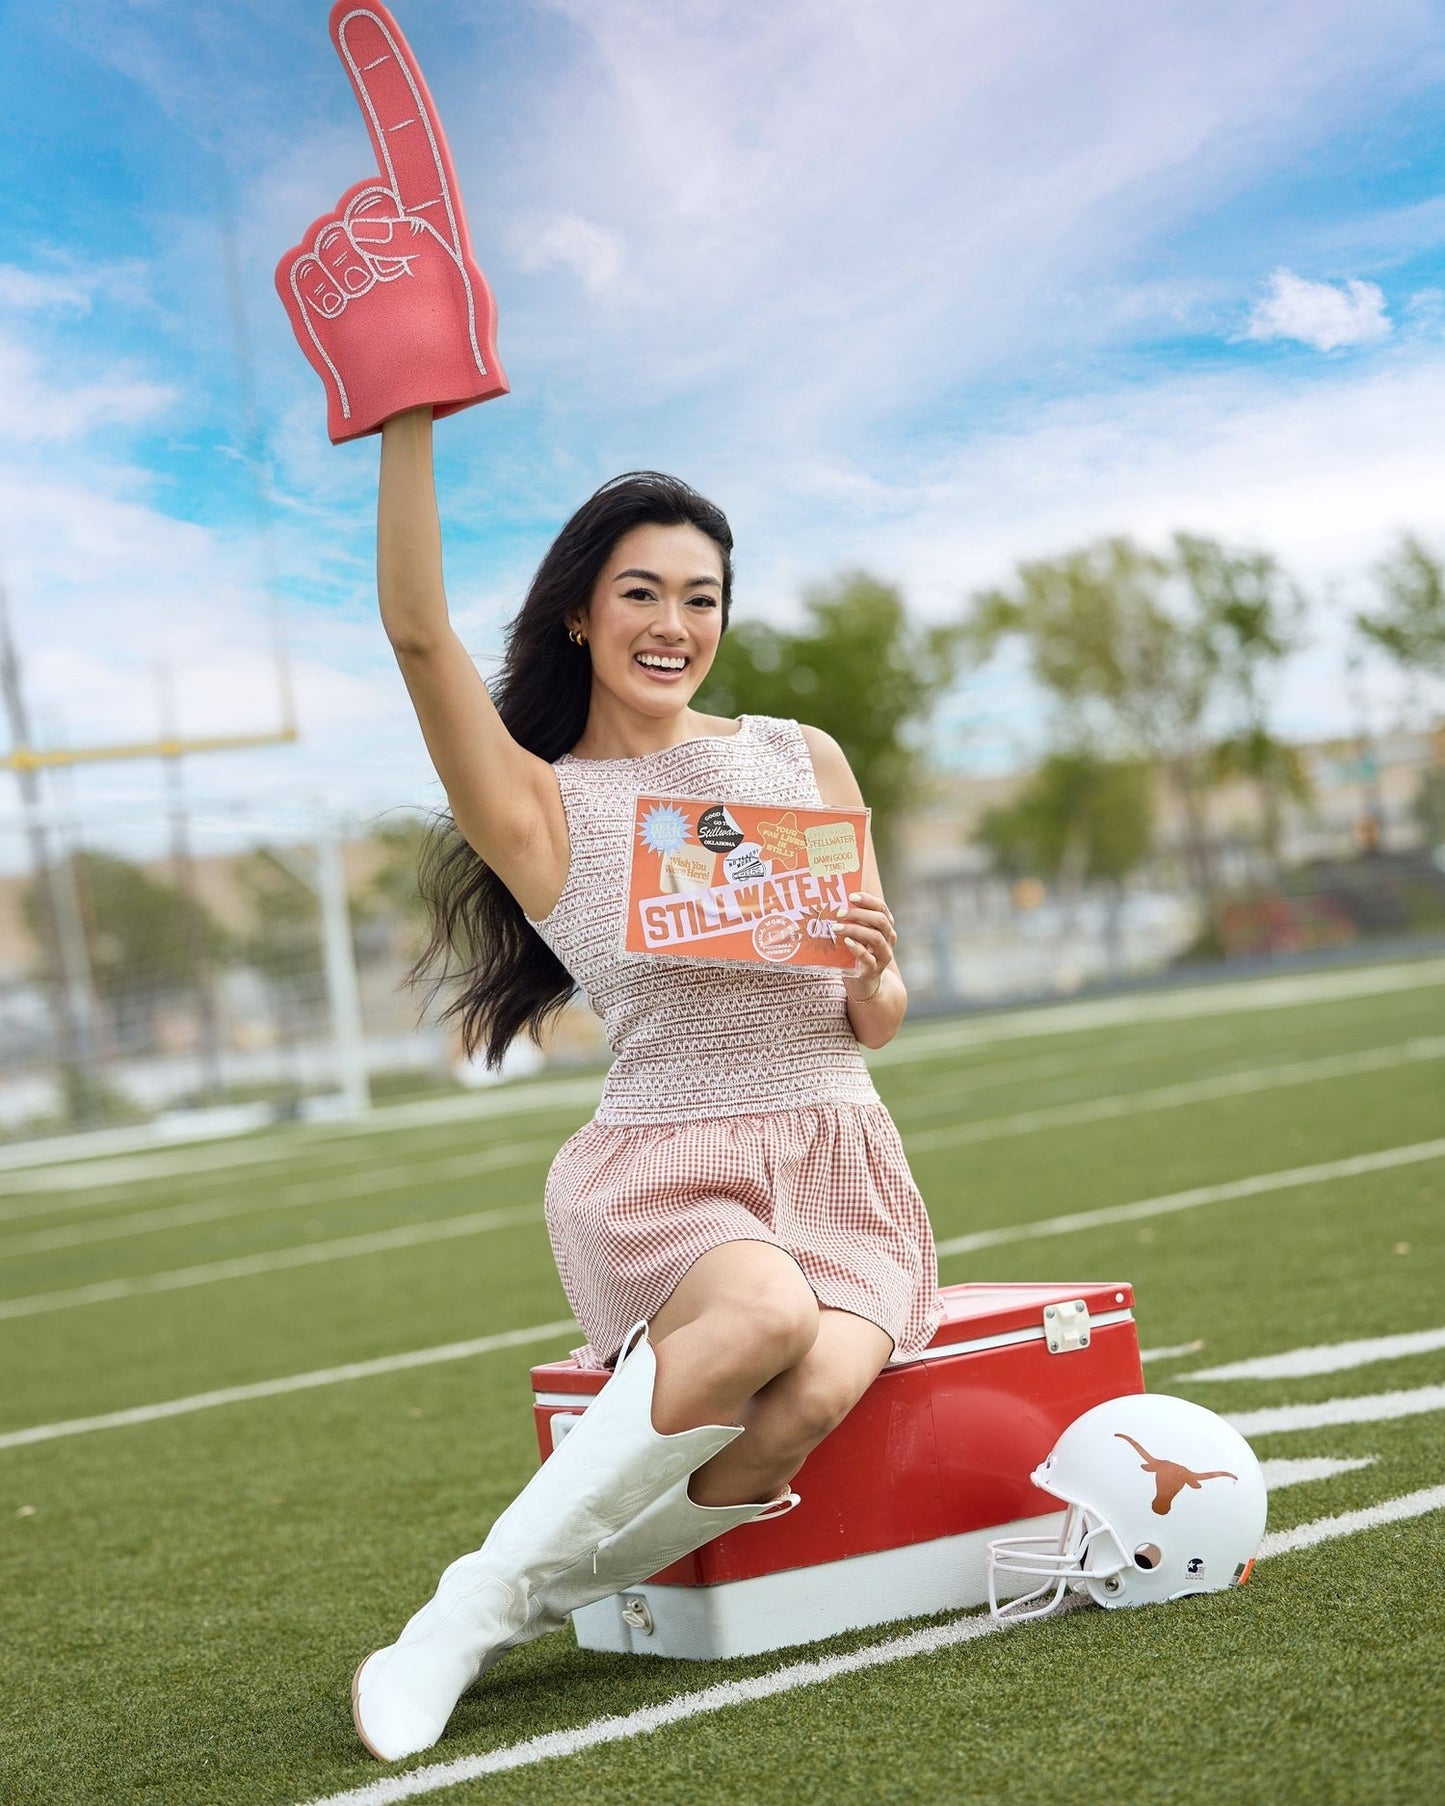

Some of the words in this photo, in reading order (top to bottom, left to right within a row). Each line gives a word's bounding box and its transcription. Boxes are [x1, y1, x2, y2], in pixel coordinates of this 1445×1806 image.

[776, 825, 797, 837] YOUR
[703, 839, 736, 847] OKLAHOMA
[808, 834, 855, 849] STILLWATER
[766, 844, 795, 858] STILLY
[832, 851, 853, 862] GOOD
[692, 860, 707, 872] You
[686, 868, 710, 881] Here!
[645, 873, 842, 941] STILLWATER
